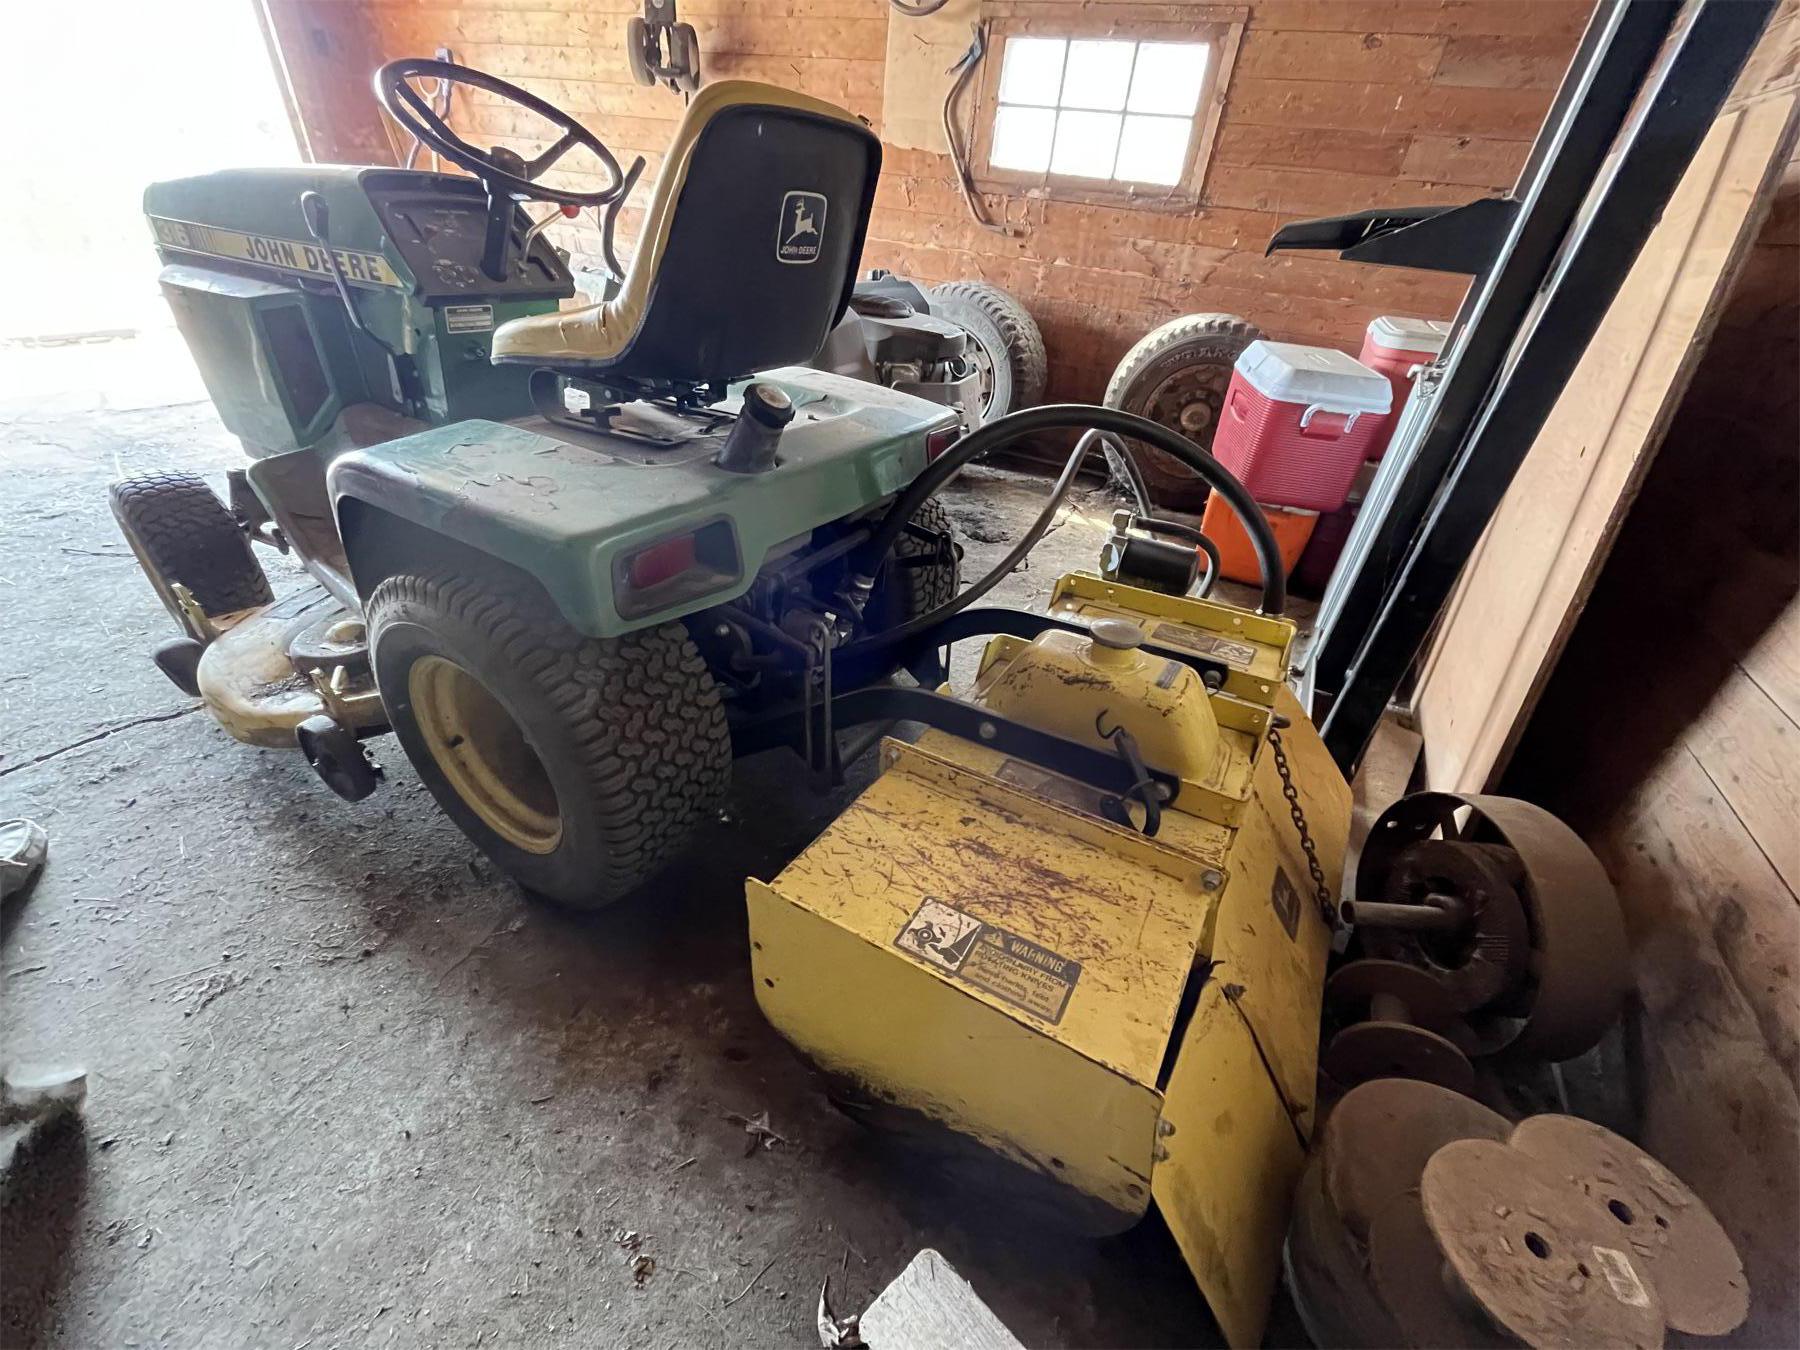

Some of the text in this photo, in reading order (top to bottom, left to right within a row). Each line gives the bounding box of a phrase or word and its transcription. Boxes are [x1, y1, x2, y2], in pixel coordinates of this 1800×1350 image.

[246, 236, 383, 282] JOHN DEERE
[781, 246, 817, 254] JOHN DEERE
[1009, 940, 1065, 973] WARNING
